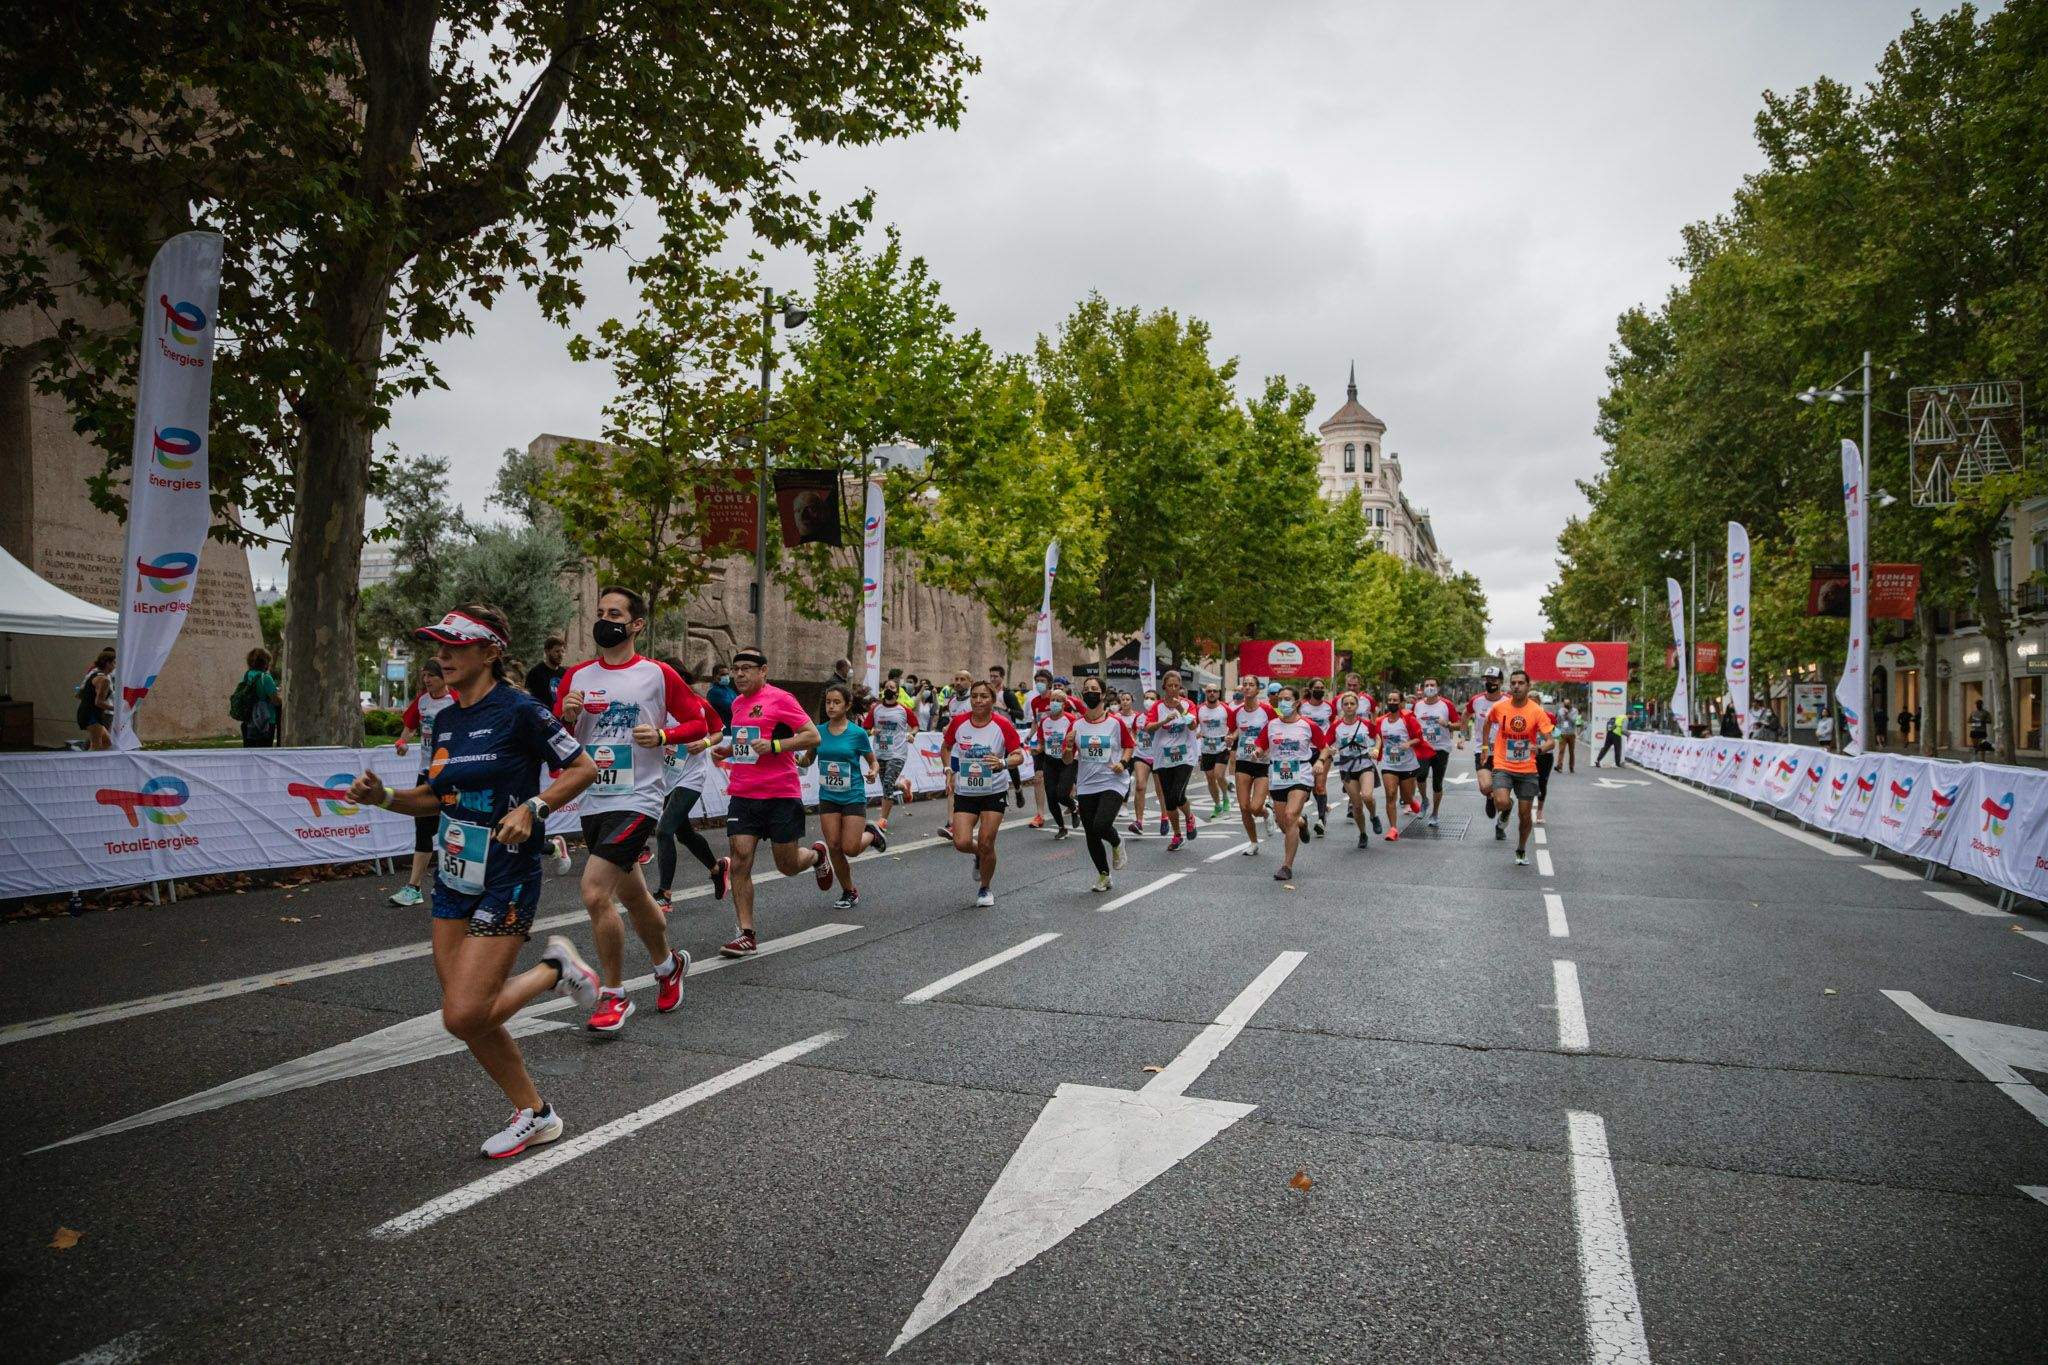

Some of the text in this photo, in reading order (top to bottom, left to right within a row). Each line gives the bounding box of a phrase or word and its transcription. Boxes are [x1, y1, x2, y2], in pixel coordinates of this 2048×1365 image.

[734, 745, 750, 757] 534
[1088, 748, 1104, 757] 528
[449, 753, 498, 764] ESTUDIANTES
[825, 776, 844, 787] 1225
[967, 777, 984, 787] 600
[295, 824, 370, 839] TotalEnergies
[104, 834, 199, 855] TotalEnergies
[443, 855, 467, 879] 557
